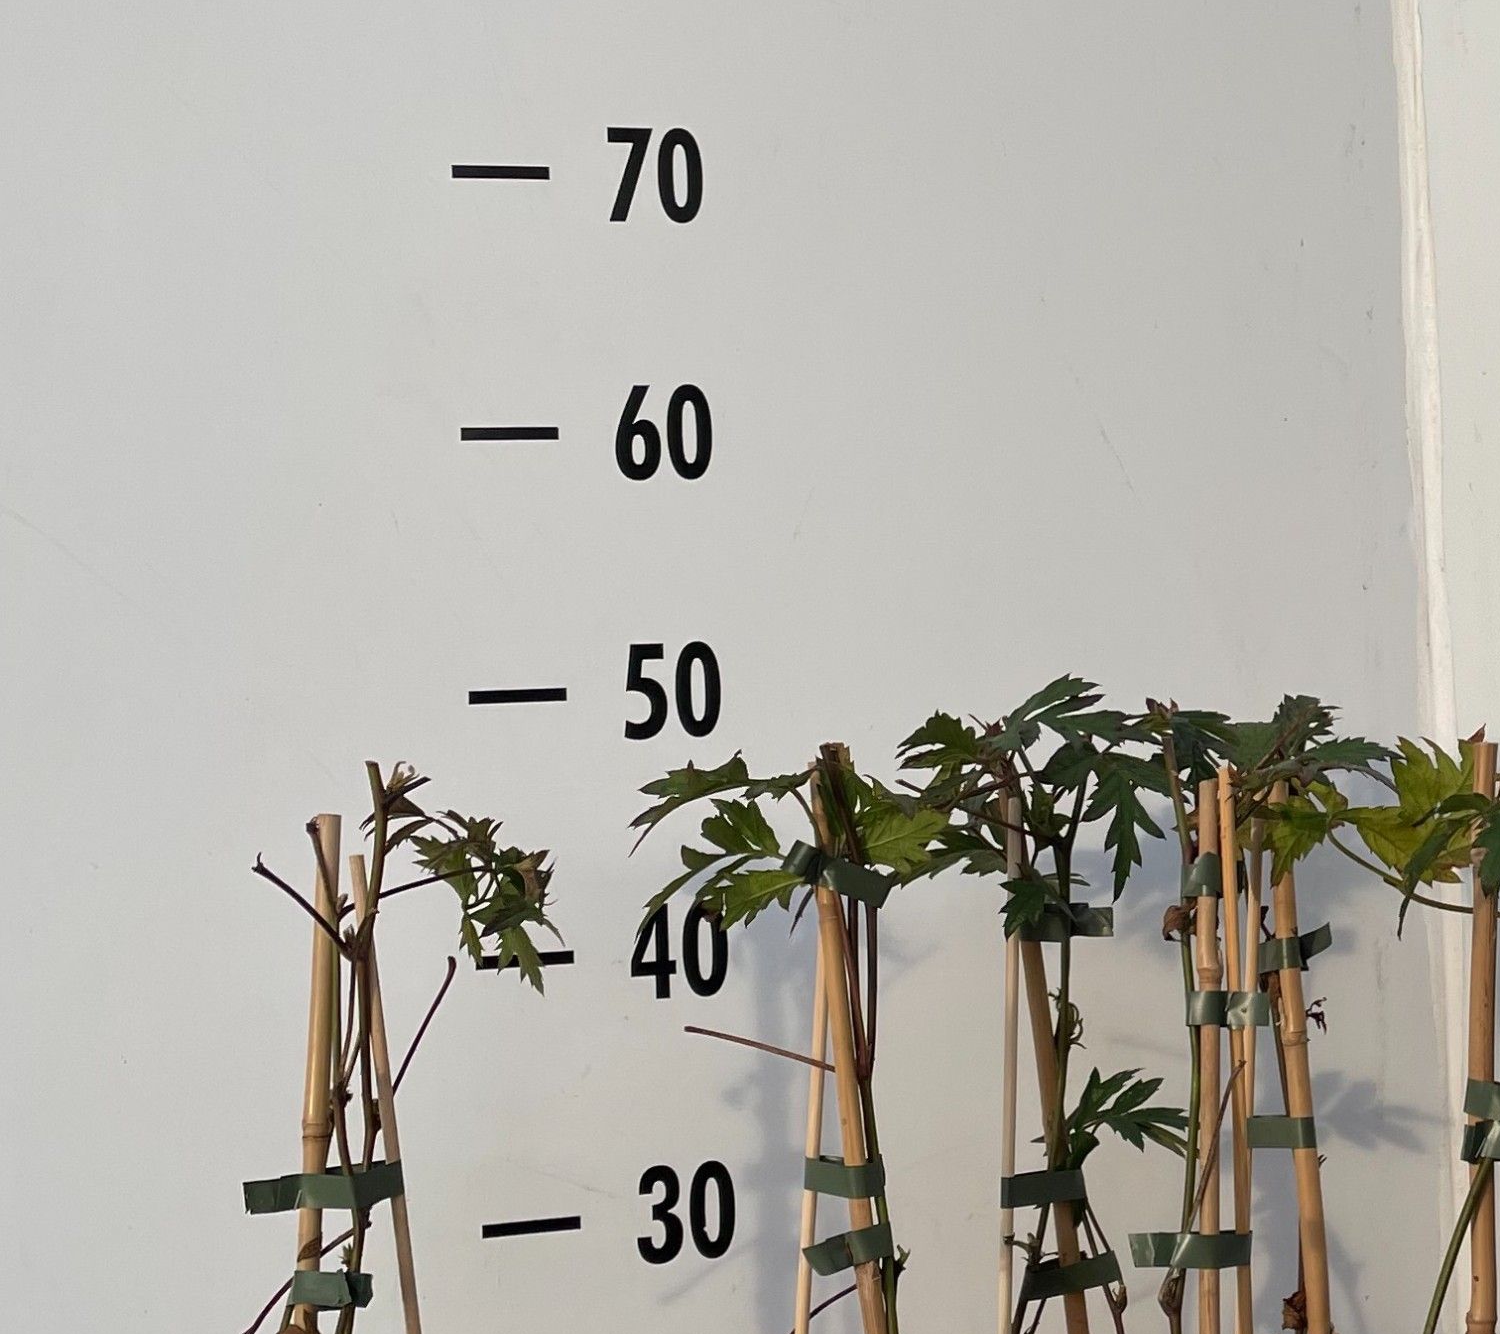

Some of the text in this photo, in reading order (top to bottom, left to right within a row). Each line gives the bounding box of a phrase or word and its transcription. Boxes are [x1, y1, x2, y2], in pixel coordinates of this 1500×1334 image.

[607, 127, 703, 224] 70
[615, 384, 713, 481] 60
[624, 641, 721, 741] 50
[631, 899, 729, 999] 40
[637, 1160, 736, 1265] 30
